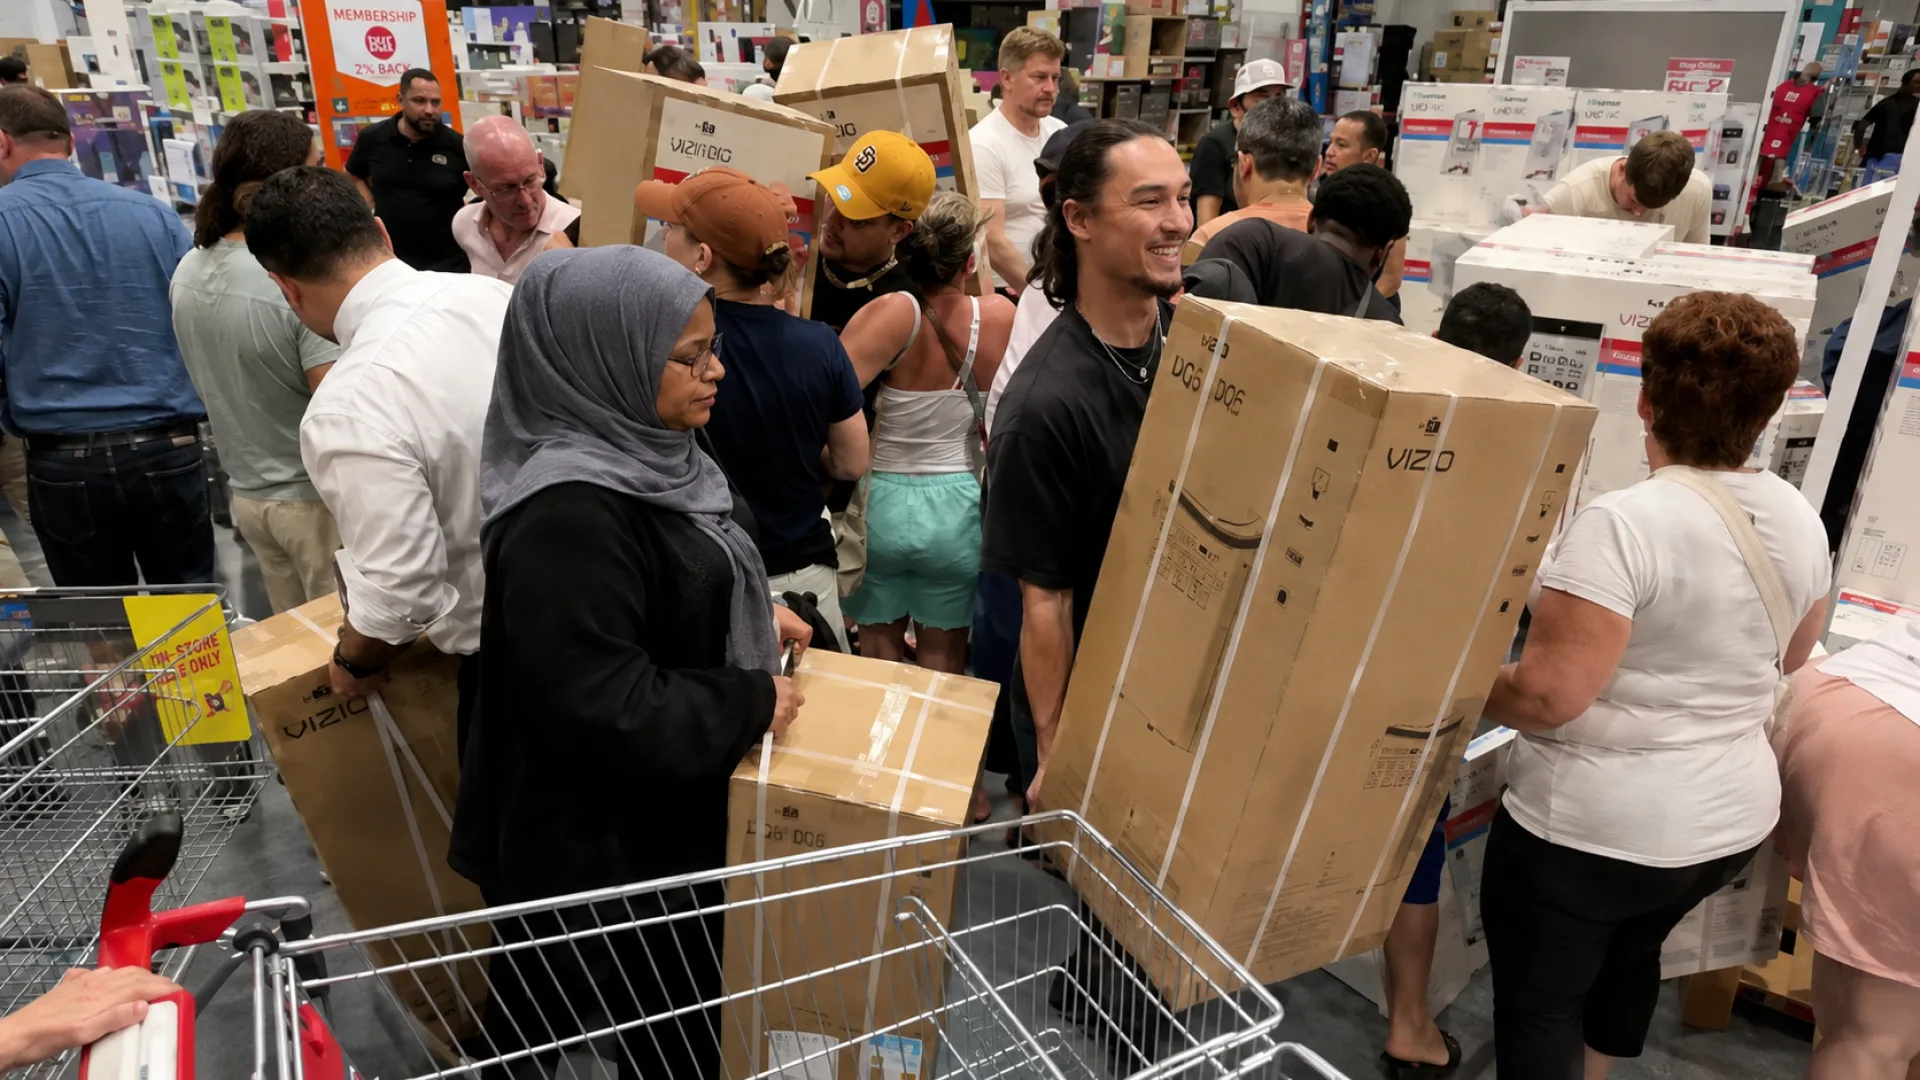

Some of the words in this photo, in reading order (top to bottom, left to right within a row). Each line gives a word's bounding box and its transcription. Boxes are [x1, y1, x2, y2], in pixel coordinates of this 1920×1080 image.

[333, 8, 416, 23] MEMBERSHIP
[378, 63, 411, 75] BACK
[1387, 447, 1455, 472] VIZO
[188, 650, 221, 674] ONLY
